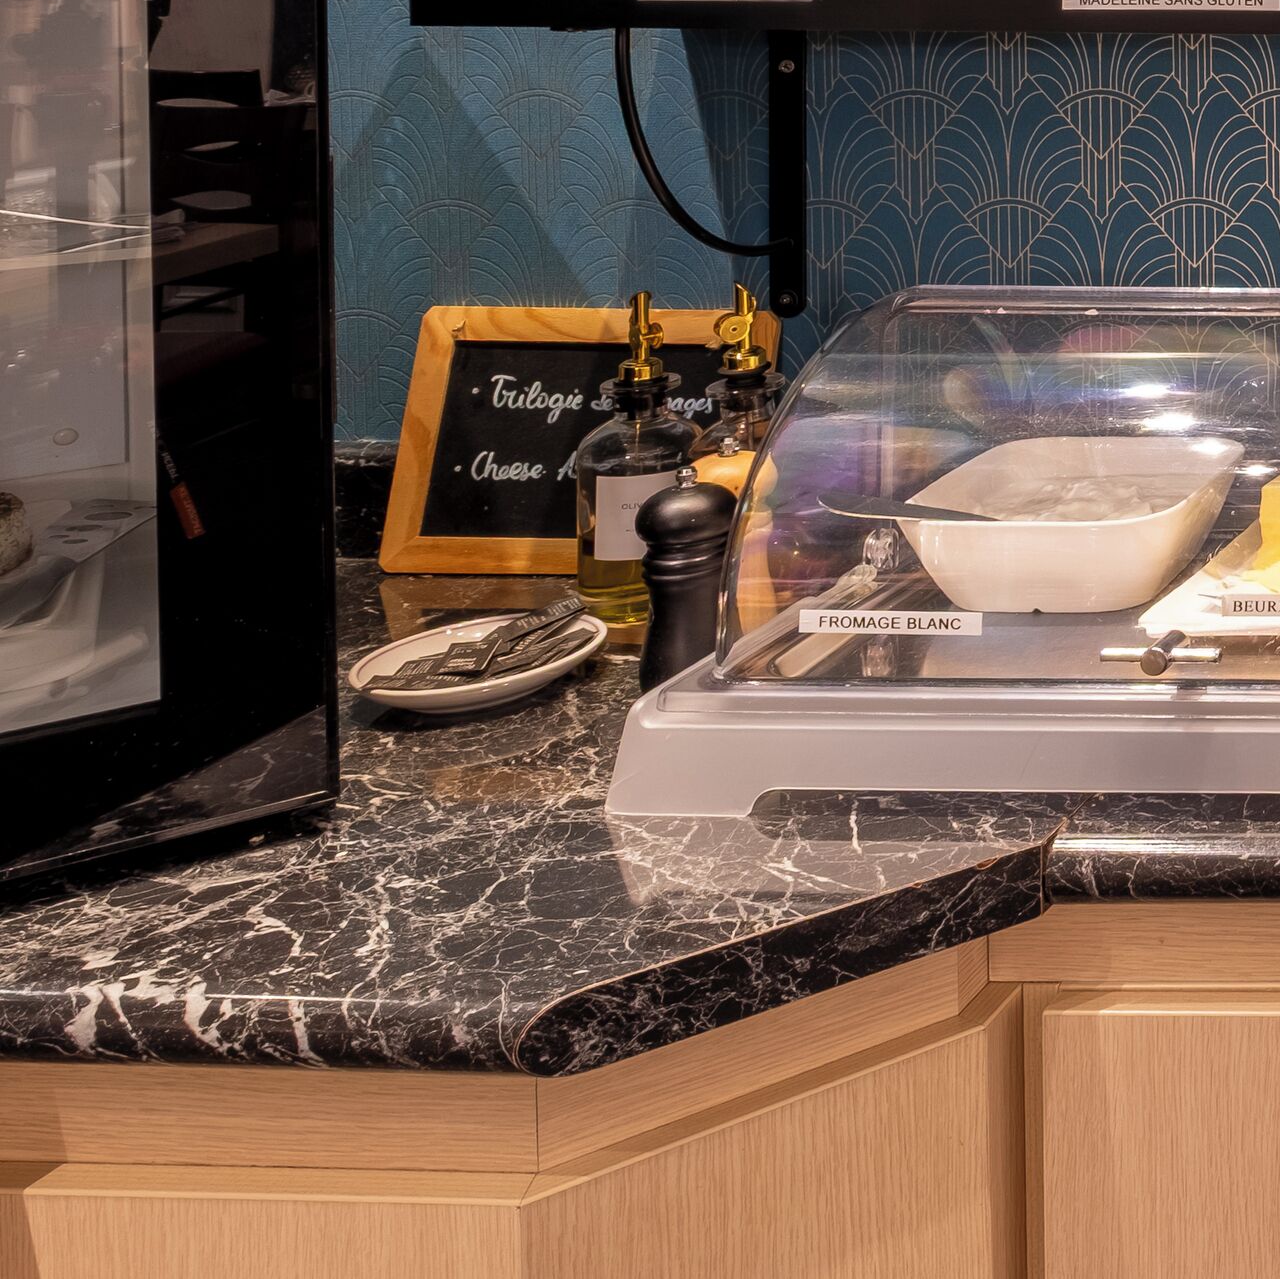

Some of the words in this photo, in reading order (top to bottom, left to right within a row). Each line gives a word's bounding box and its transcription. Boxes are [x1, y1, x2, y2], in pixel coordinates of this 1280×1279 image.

[490, 374, 585, 424] Trilogie
[666, 396, 713, 419] ages
[818, 615, 901, 630] FROMAGE
[906, 617, 962, 631] BLANC
